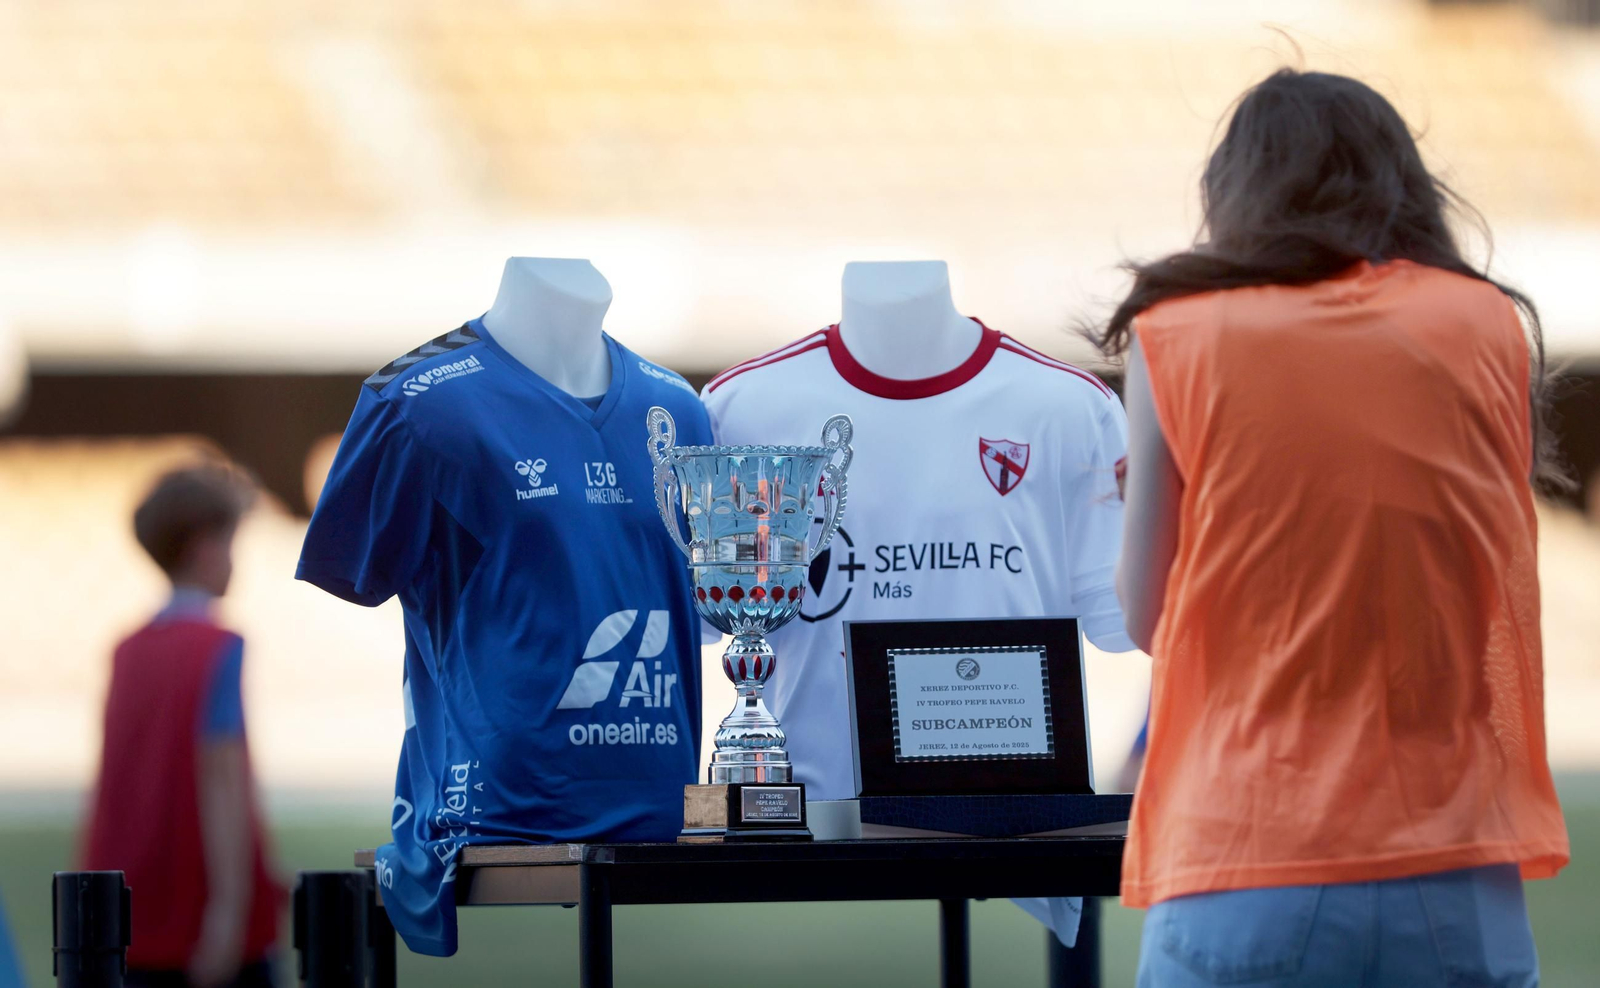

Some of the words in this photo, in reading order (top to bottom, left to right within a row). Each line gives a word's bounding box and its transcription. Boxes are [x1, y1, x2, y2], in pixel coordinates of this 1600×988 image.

[425, 355, 480, 380] romeral
[584, 462, 617, 487] L3G
[516, 483, 558, 500] hummel
[875, 542, 980, 573] SEVILLA
[990, 543, 1023, 573] FC
[873, 581, 912, 599] Más
[619, 661, 677, 708] Air
[927, 699, 962, 707] TROFEO
[569, 716, 678, 745] oneair.es
[912, 715, 1033, 731] SUBCAMPEÓN
[918, 743, 948, 751] JEREZ,
[971, 742, 999, 750] Agosto
